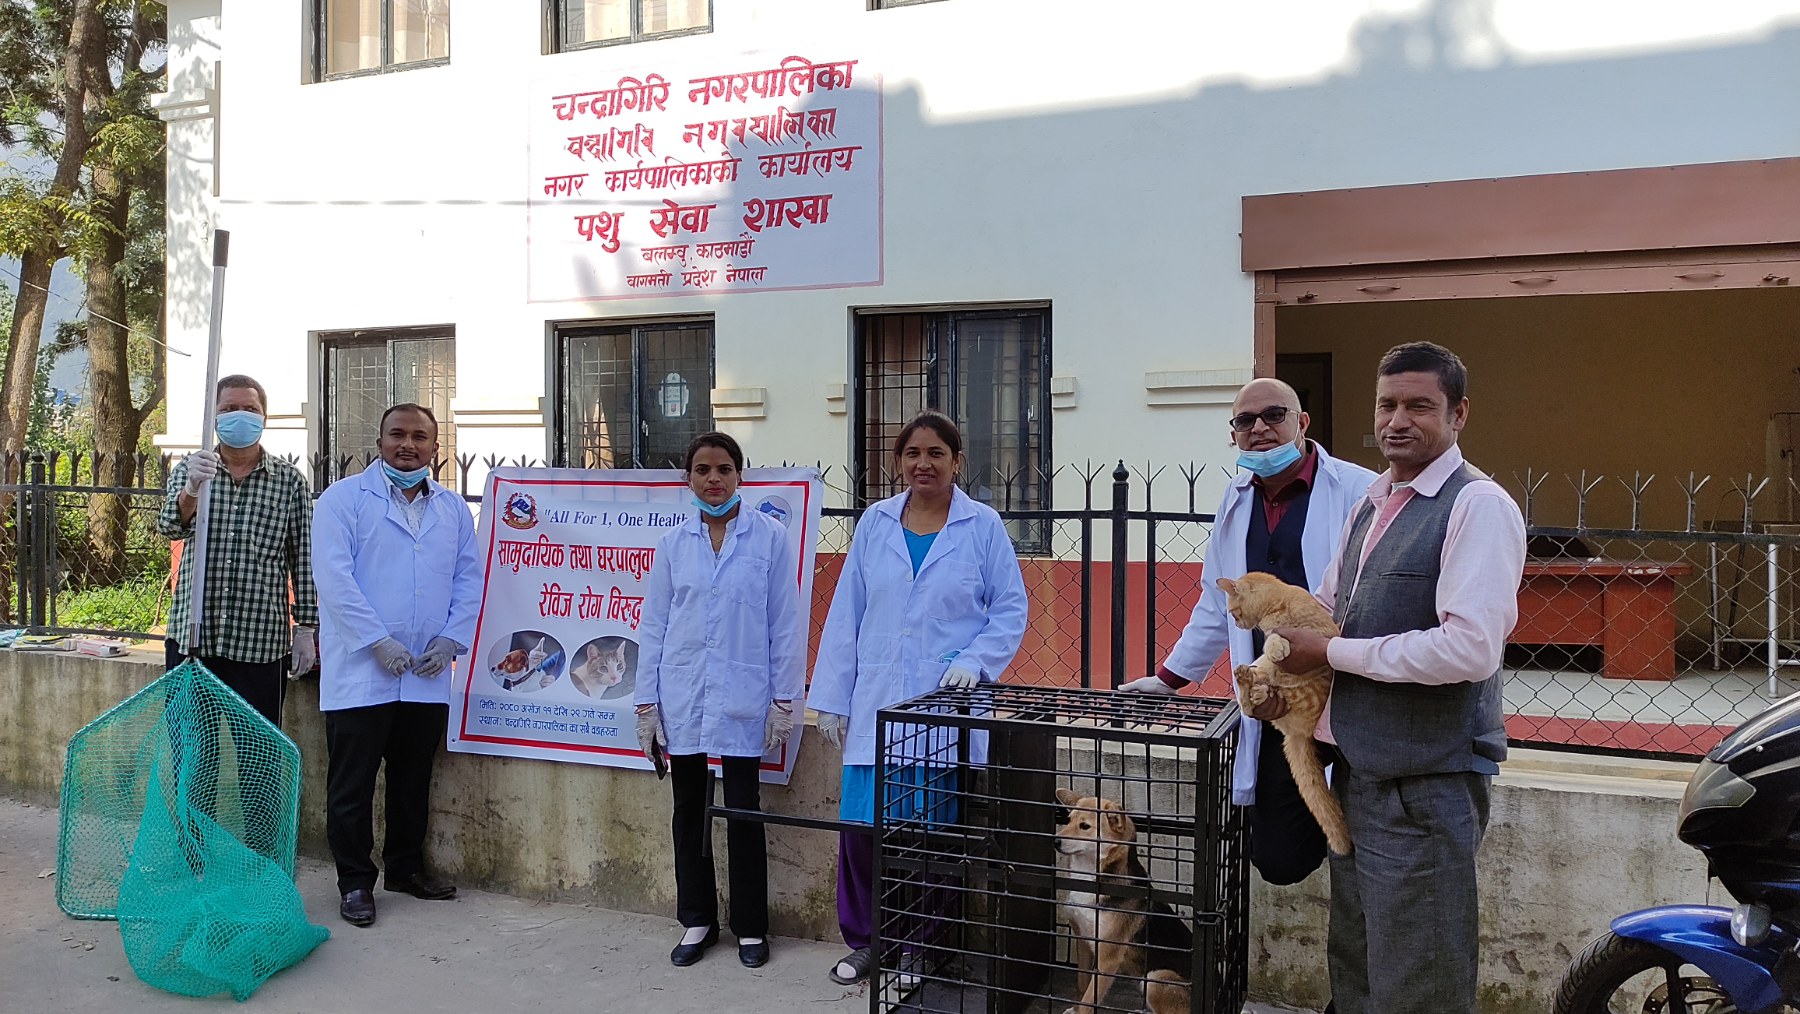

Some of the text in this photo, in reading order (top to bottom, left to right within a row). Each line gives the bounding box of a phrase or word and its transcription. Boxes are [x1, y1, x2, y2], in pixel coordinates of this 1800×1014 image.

[552, 55, 859, 121] चन्द्रागिरि नगरपालिका
[544, 141, 863, 197] नगर कार्यपालिकाको कार्यालय
[574, 194, 833, 253] पशु सेवा शाखा
[681, 266, 717, 288] प्रदेश
[726, 264, 768, 285] नेपाल
[573, 511, 597, 525] For
[601, 511, 612, 528] 1,
[617, 512, 643, 526] One
[498, 533, 565, 573] सामुदायिक
[569, 544, 593, 571] तथा
[539, 582, 574, 617] रेविज
[578, 585, 604, 619] रोग
[479, 699, 497, 710] मिति:
[500, 703, 519, 712] २०८०
[521, 702, 541, 713] असोज
[554, 705, 568, 716] देखि
[582, 708, 595, 718] गते
[479, 715, 502, 726] स्थान:
